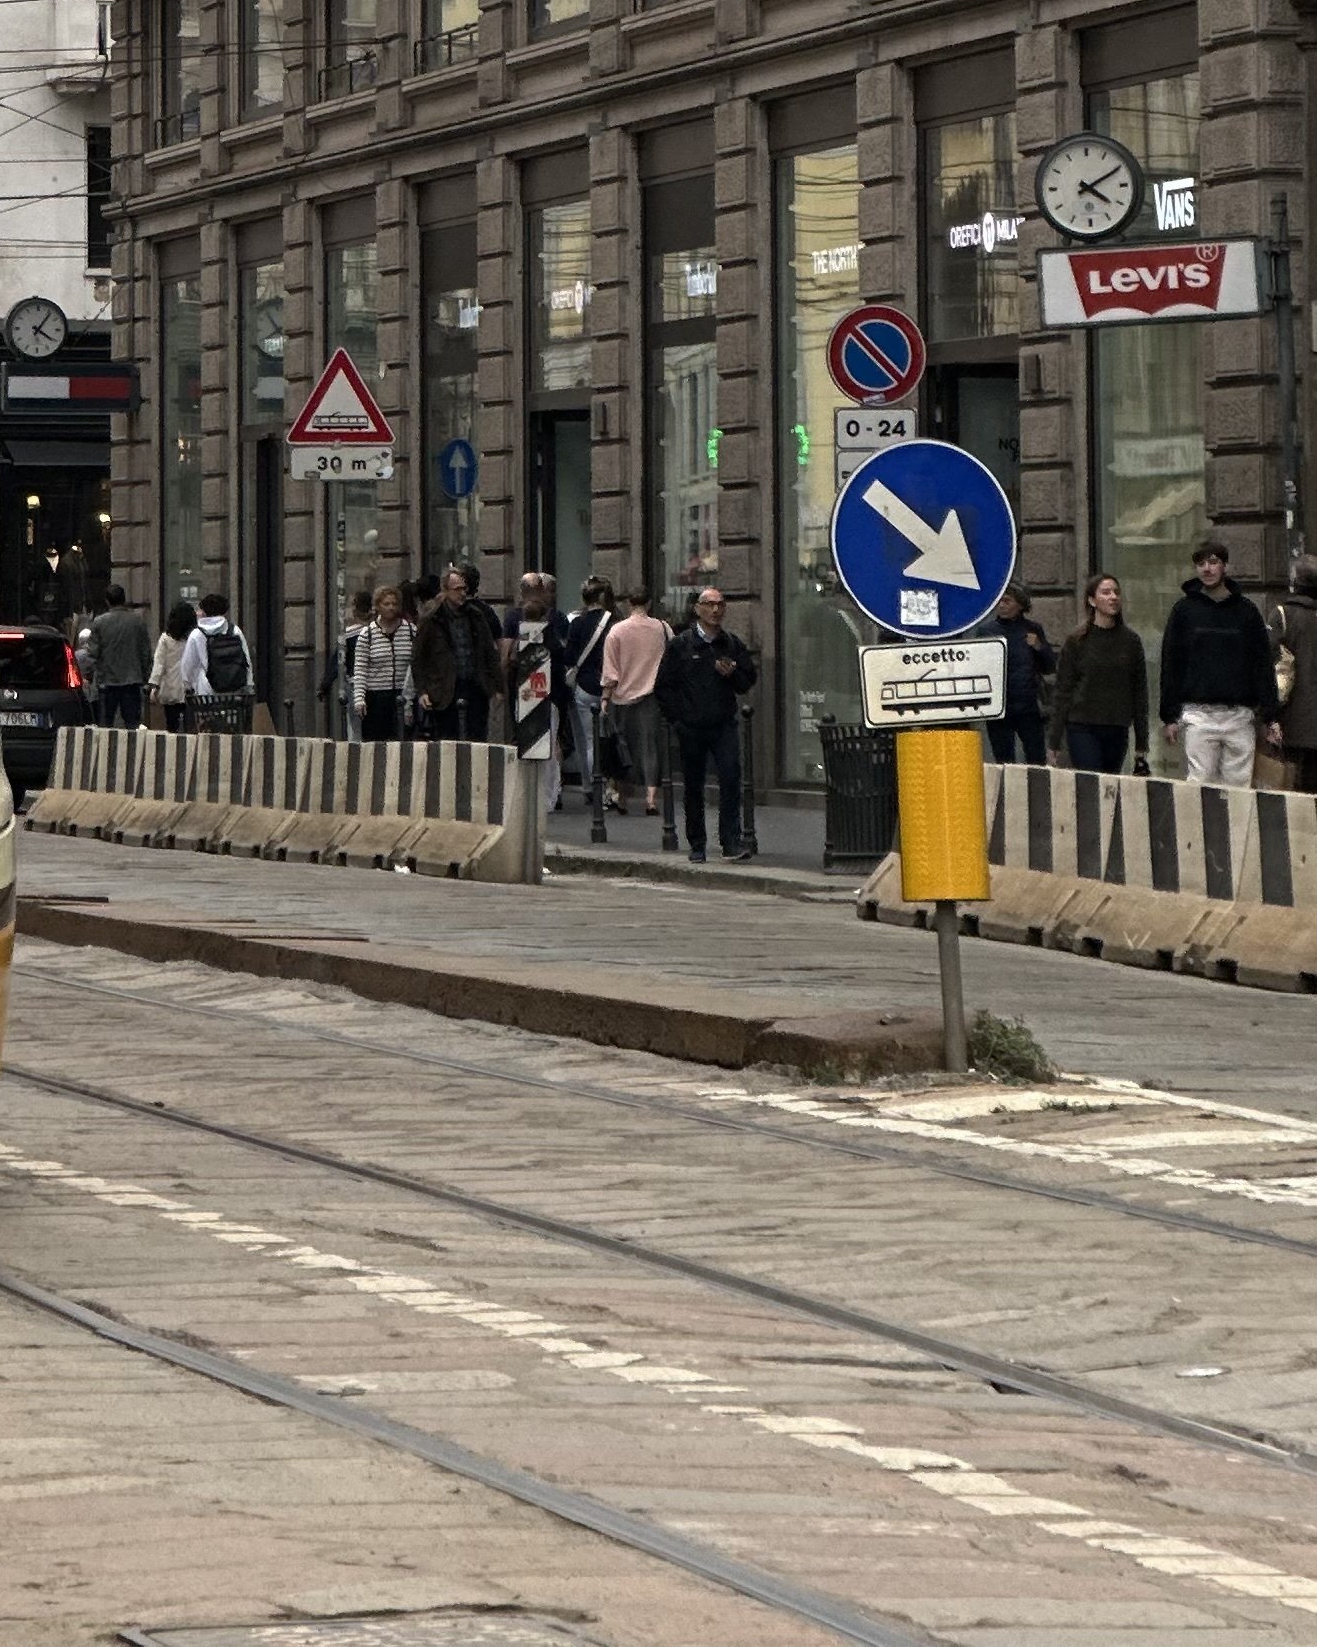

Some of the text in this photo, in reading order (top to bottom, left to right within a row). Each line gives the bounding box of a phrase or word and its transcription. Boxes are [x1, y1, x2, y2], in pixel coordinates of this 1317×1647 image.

[1153, 178, 1194, 230] VANS
[846, 420, 861, 437] 0
[878, 420, 907, 437] 24
[317, 456, 367, 471] 30 m
[902, 649, 970, 665] eccetto:
